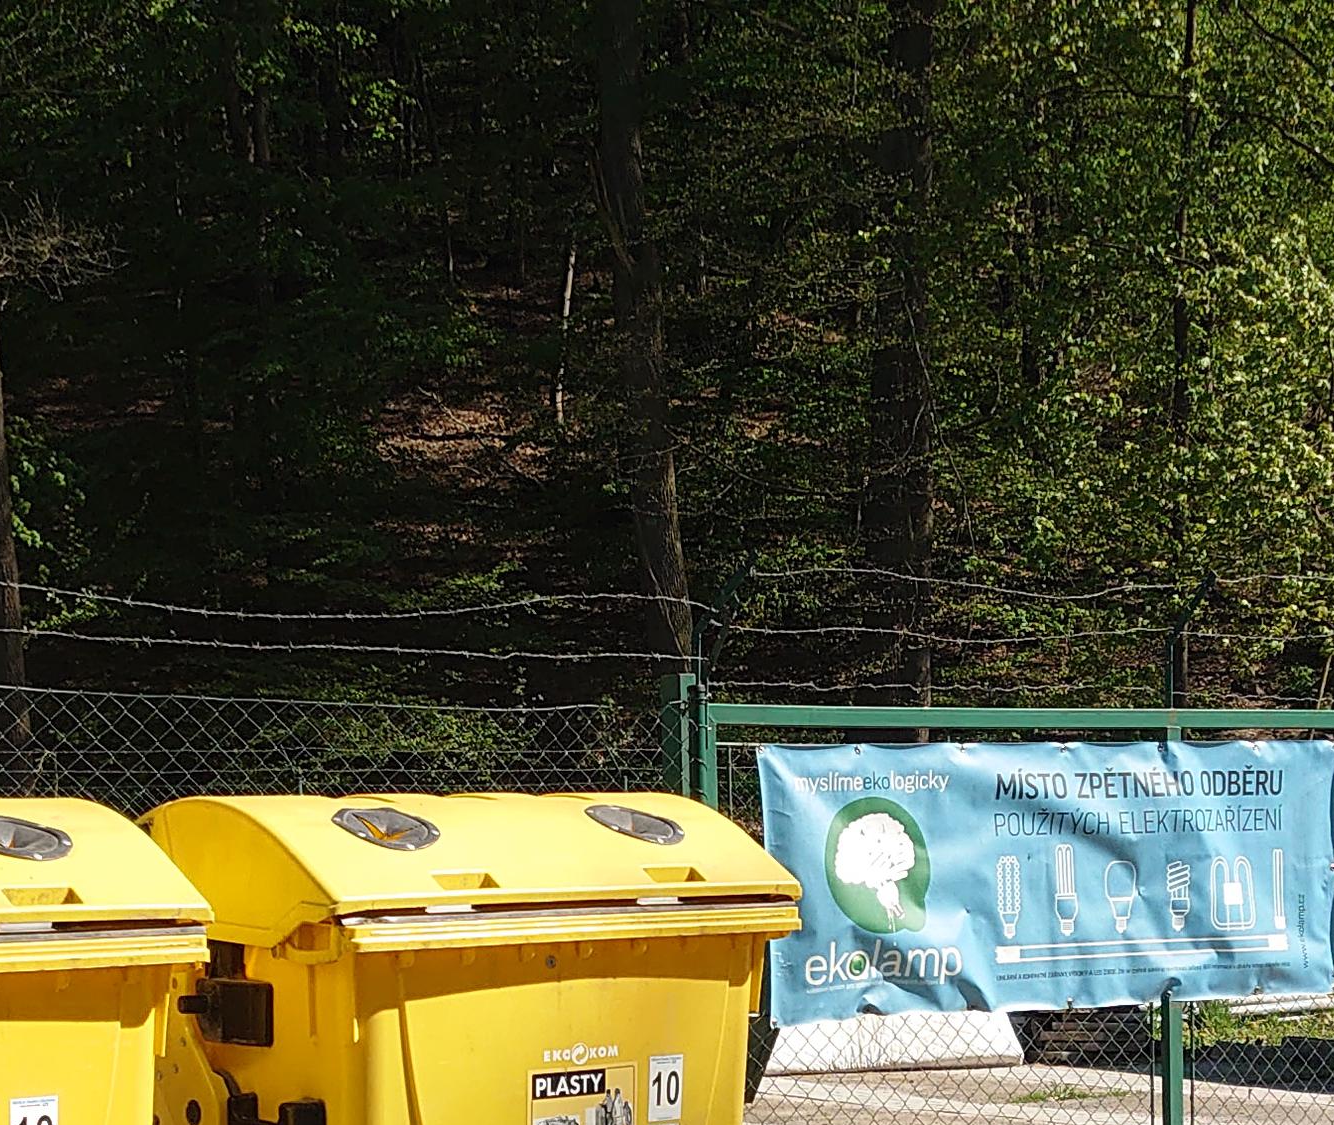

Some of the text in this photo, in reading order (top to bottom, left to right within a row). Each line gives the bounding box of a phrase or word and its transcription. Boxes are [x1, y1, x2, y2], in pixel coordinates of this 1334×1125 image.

[794, 769, 950, 795] myslímeekologicky
[995, 765, 1284, 801] MÍSTO ZPĚTNÉHO ODBĚRU
[994, 804, 1283, 837] POUŽITÝCH ELEKTROZAŘÍZENÍ
[1297, 893, 1309, 969] www.ekolamp.cz
[805, 939, 964, 985] ekolamp
[535, 1073, 603, 1098] PLASTY
[651, 1071, 680, 1106] 10
